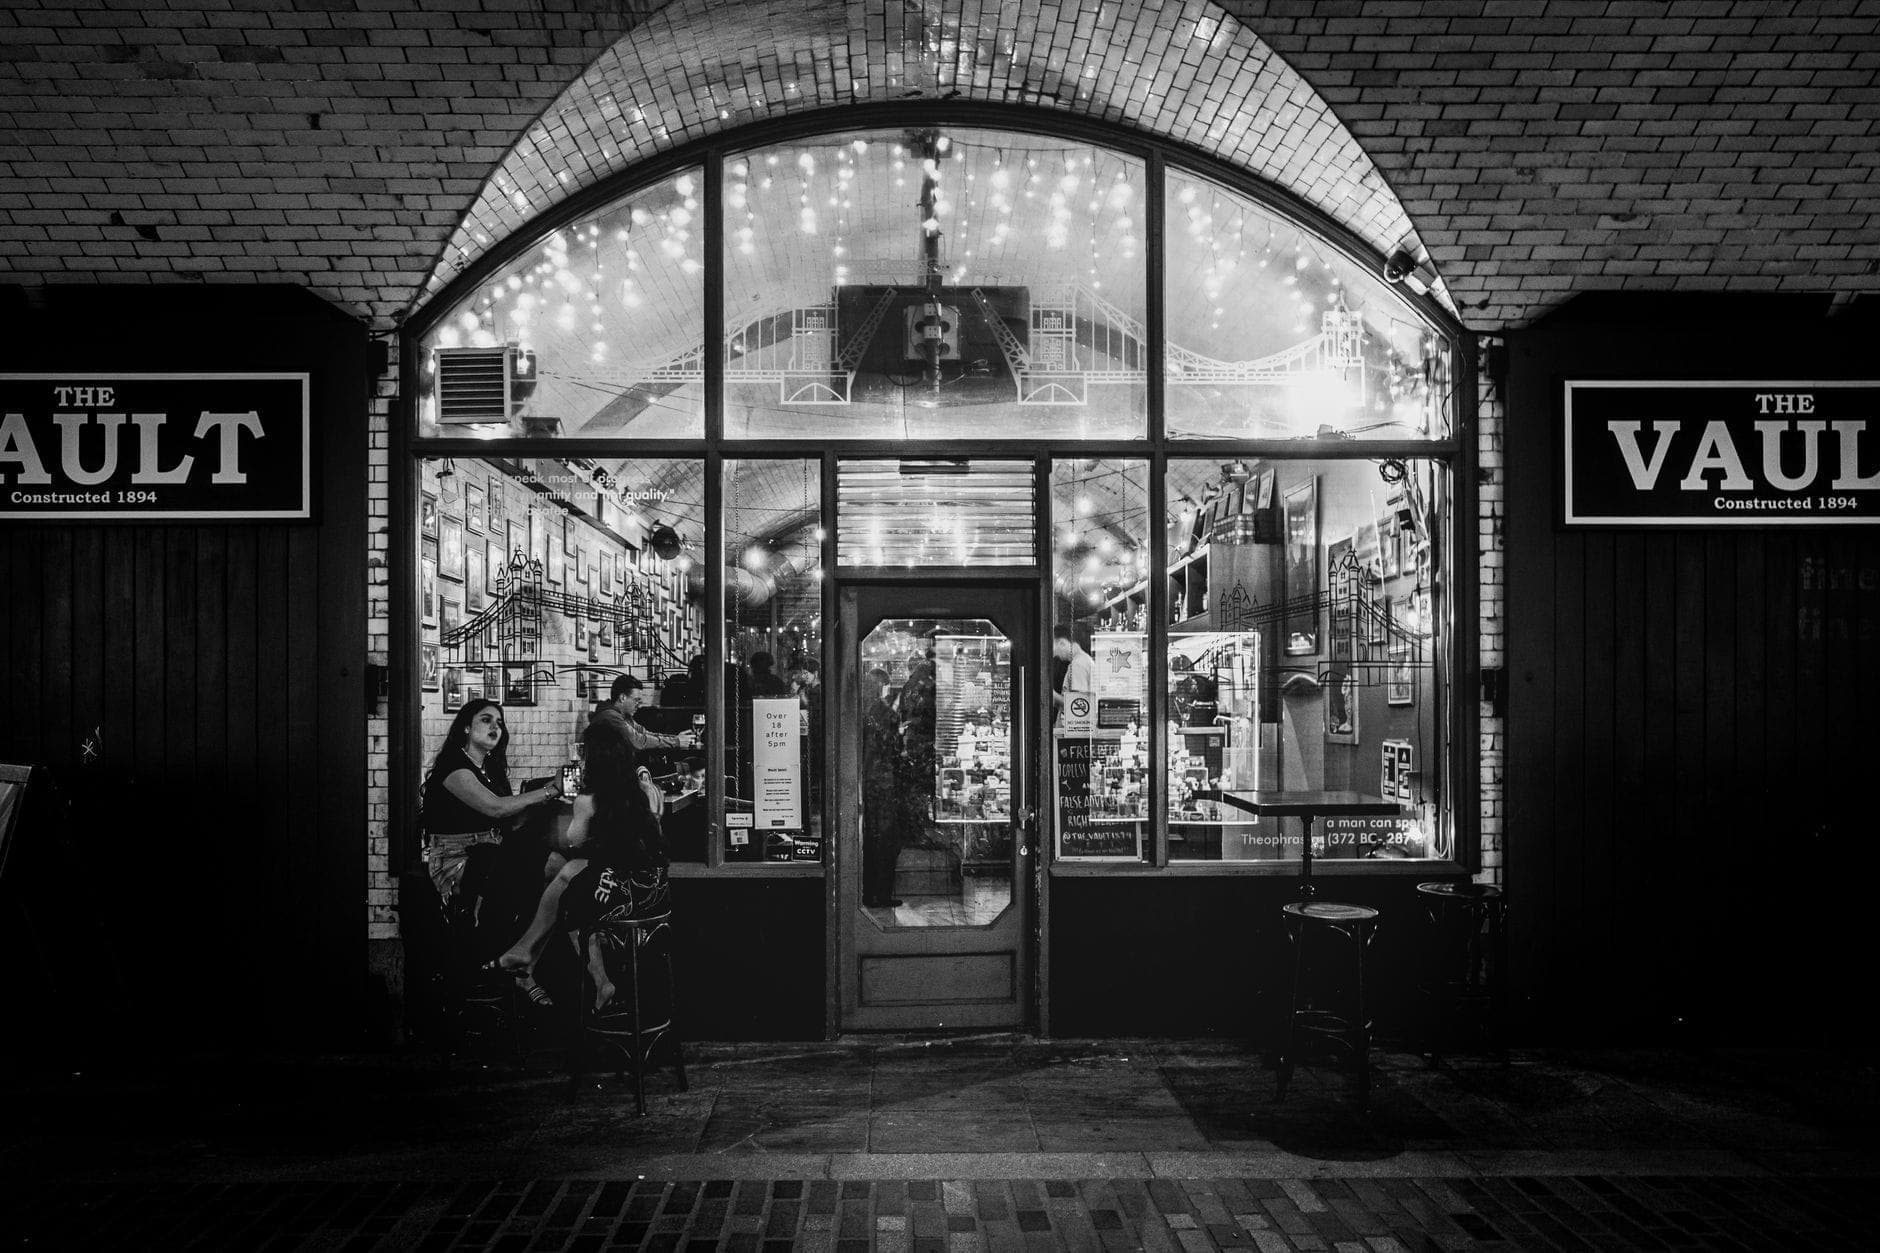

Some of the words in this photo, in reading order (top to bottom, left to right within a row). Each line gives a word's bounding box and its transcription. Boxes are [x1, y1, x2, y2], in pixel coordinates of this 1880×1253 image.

[54, 386, 115, 407] THE
[1755, 393, 1815, 414] THE
[1607, 420, 1880, 492] VAUL
[11, 490, 110, 503] Constructed
[117, 490, 157, 503] 1894
[575, 487, 597, 500] and
[1713, 497, 1811, 509] Constructed
[1819, 496, 1857, 509] 1894
[766, 712, 786, 720] Over
[772, 721, 782, 729] 18
[1327, 819, 1334, 828] a
[1339, 819, 1366, 828] man
[1370, 819, 1392, 828] can
[1395, 818, 1427, 831] spen
[1328, 831, 1355, 847] (372
